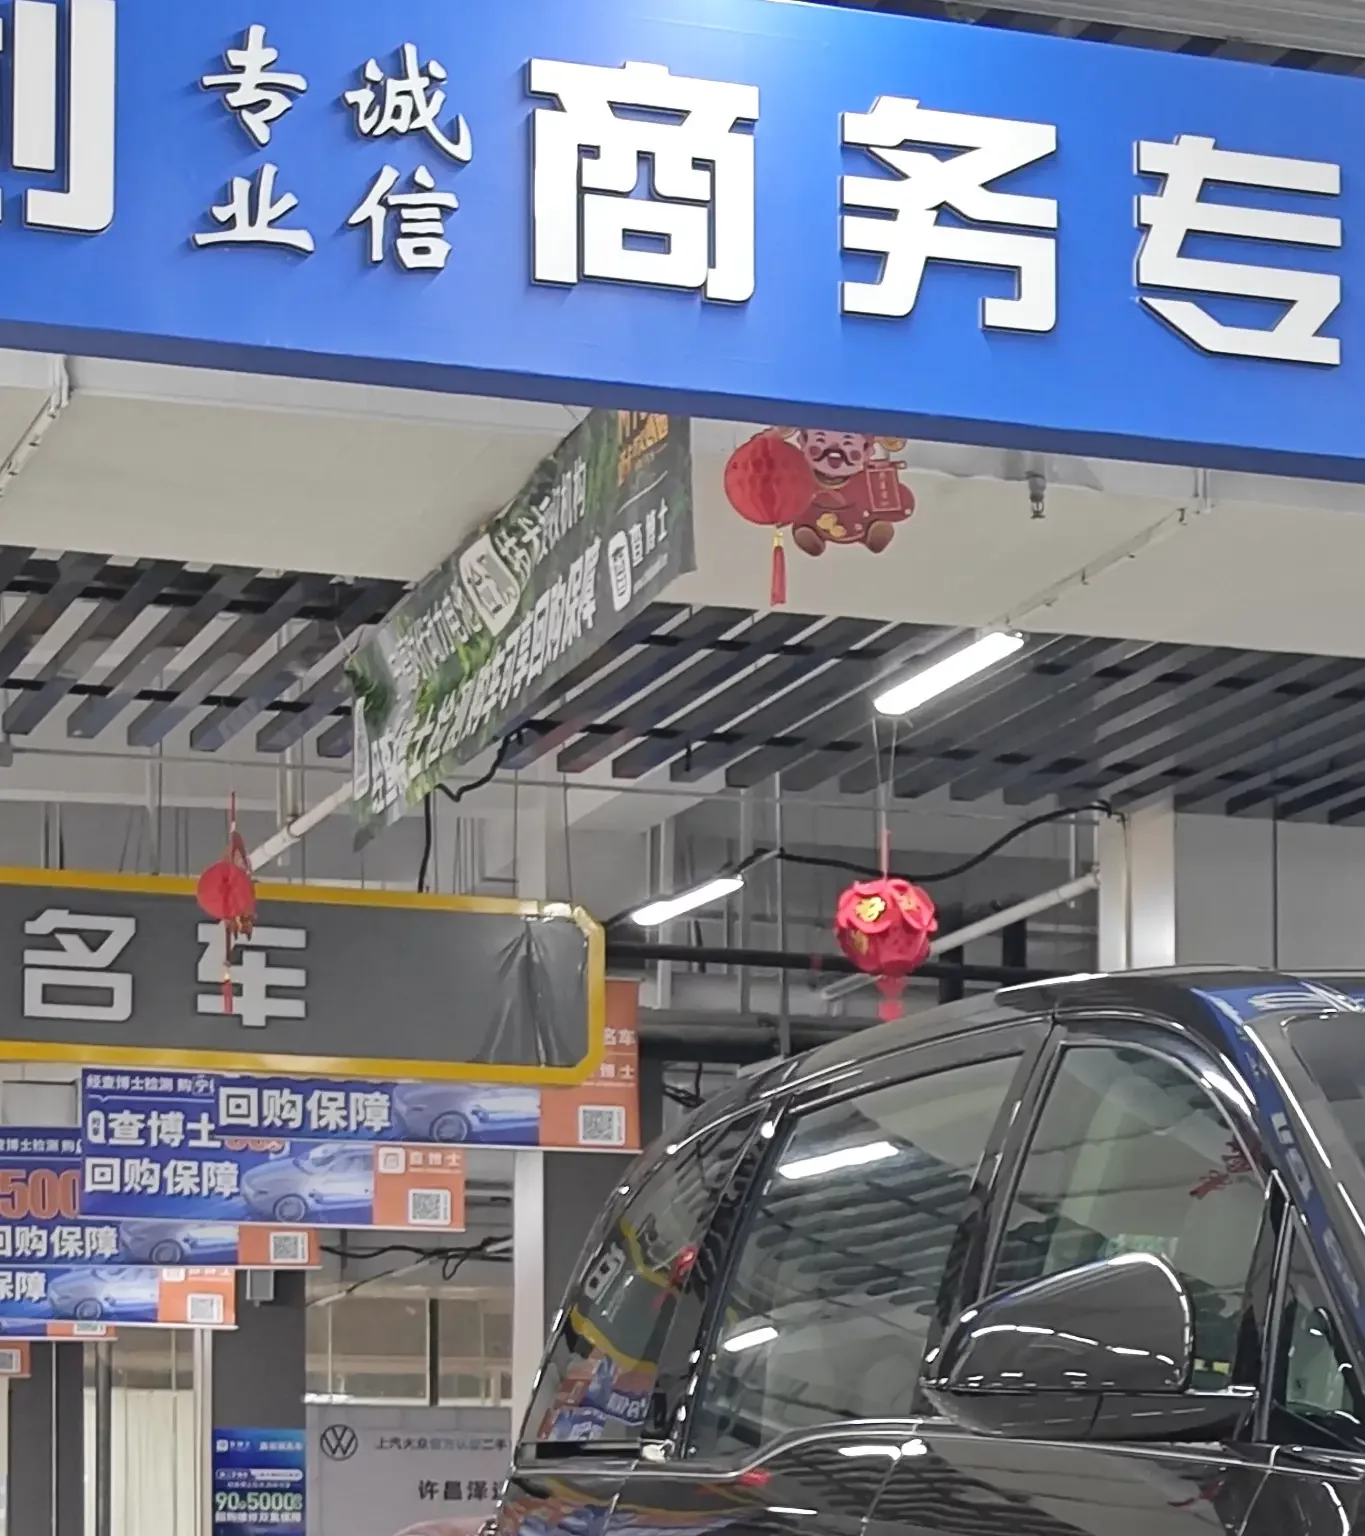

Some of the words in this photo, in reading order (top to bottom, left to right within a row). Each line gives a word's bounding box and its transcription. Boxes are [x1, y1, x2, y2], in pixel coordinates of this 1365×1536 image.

[23, 908, 307, 1028] 名车
[218, 1086, 392, 1133] 回购保障
[84, 1157, 241, 1198] 回购保障
[376, 1436, 510, 1451] 上汽大众官方认证二手
